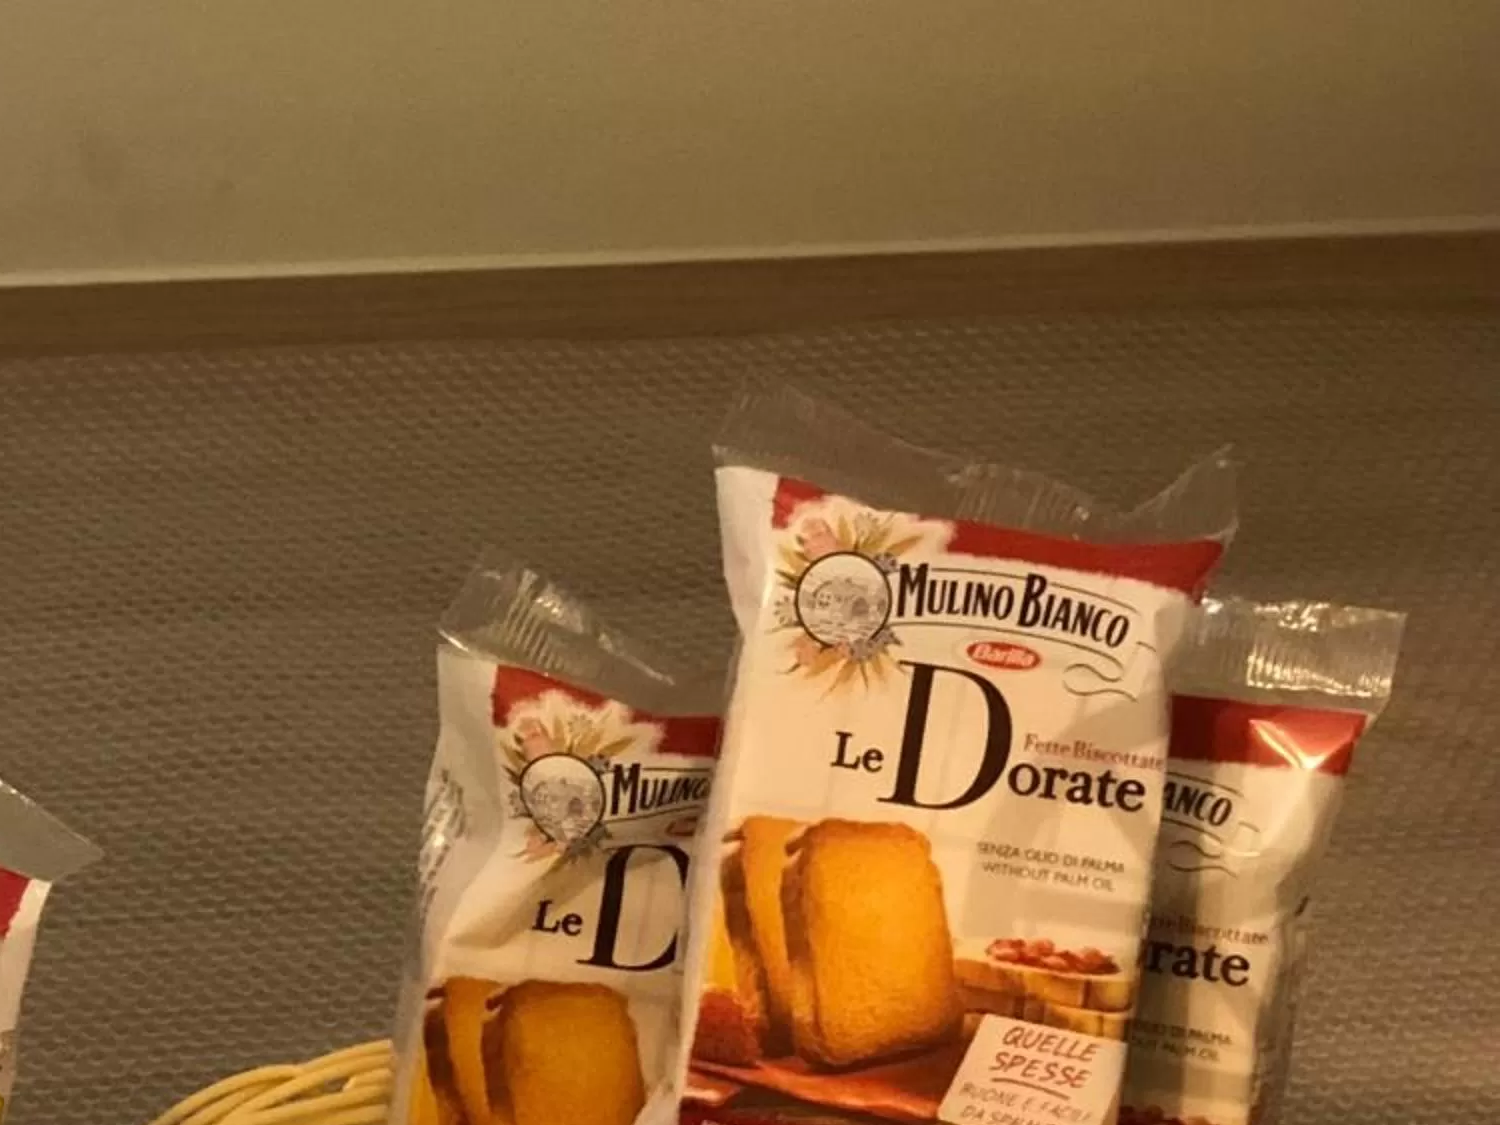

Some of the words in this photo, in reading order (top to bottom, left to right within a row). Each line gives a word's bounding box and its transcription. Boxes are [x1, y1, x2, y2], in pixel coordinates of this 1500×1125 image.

[896, 562, 1014, 621] MULINO
[1017, 573, 1130, 649] BIANCO
[831, 731, 884, 774] Le
[1164, 781, 1233, 827] ANCO
[532, 900, 583, 937] Le
[1142, 940, 1250, 987] rate
[1002, 1025, 1101, 1063] QUELLE
[990, 1052, 1091, 1089] SPESSE
